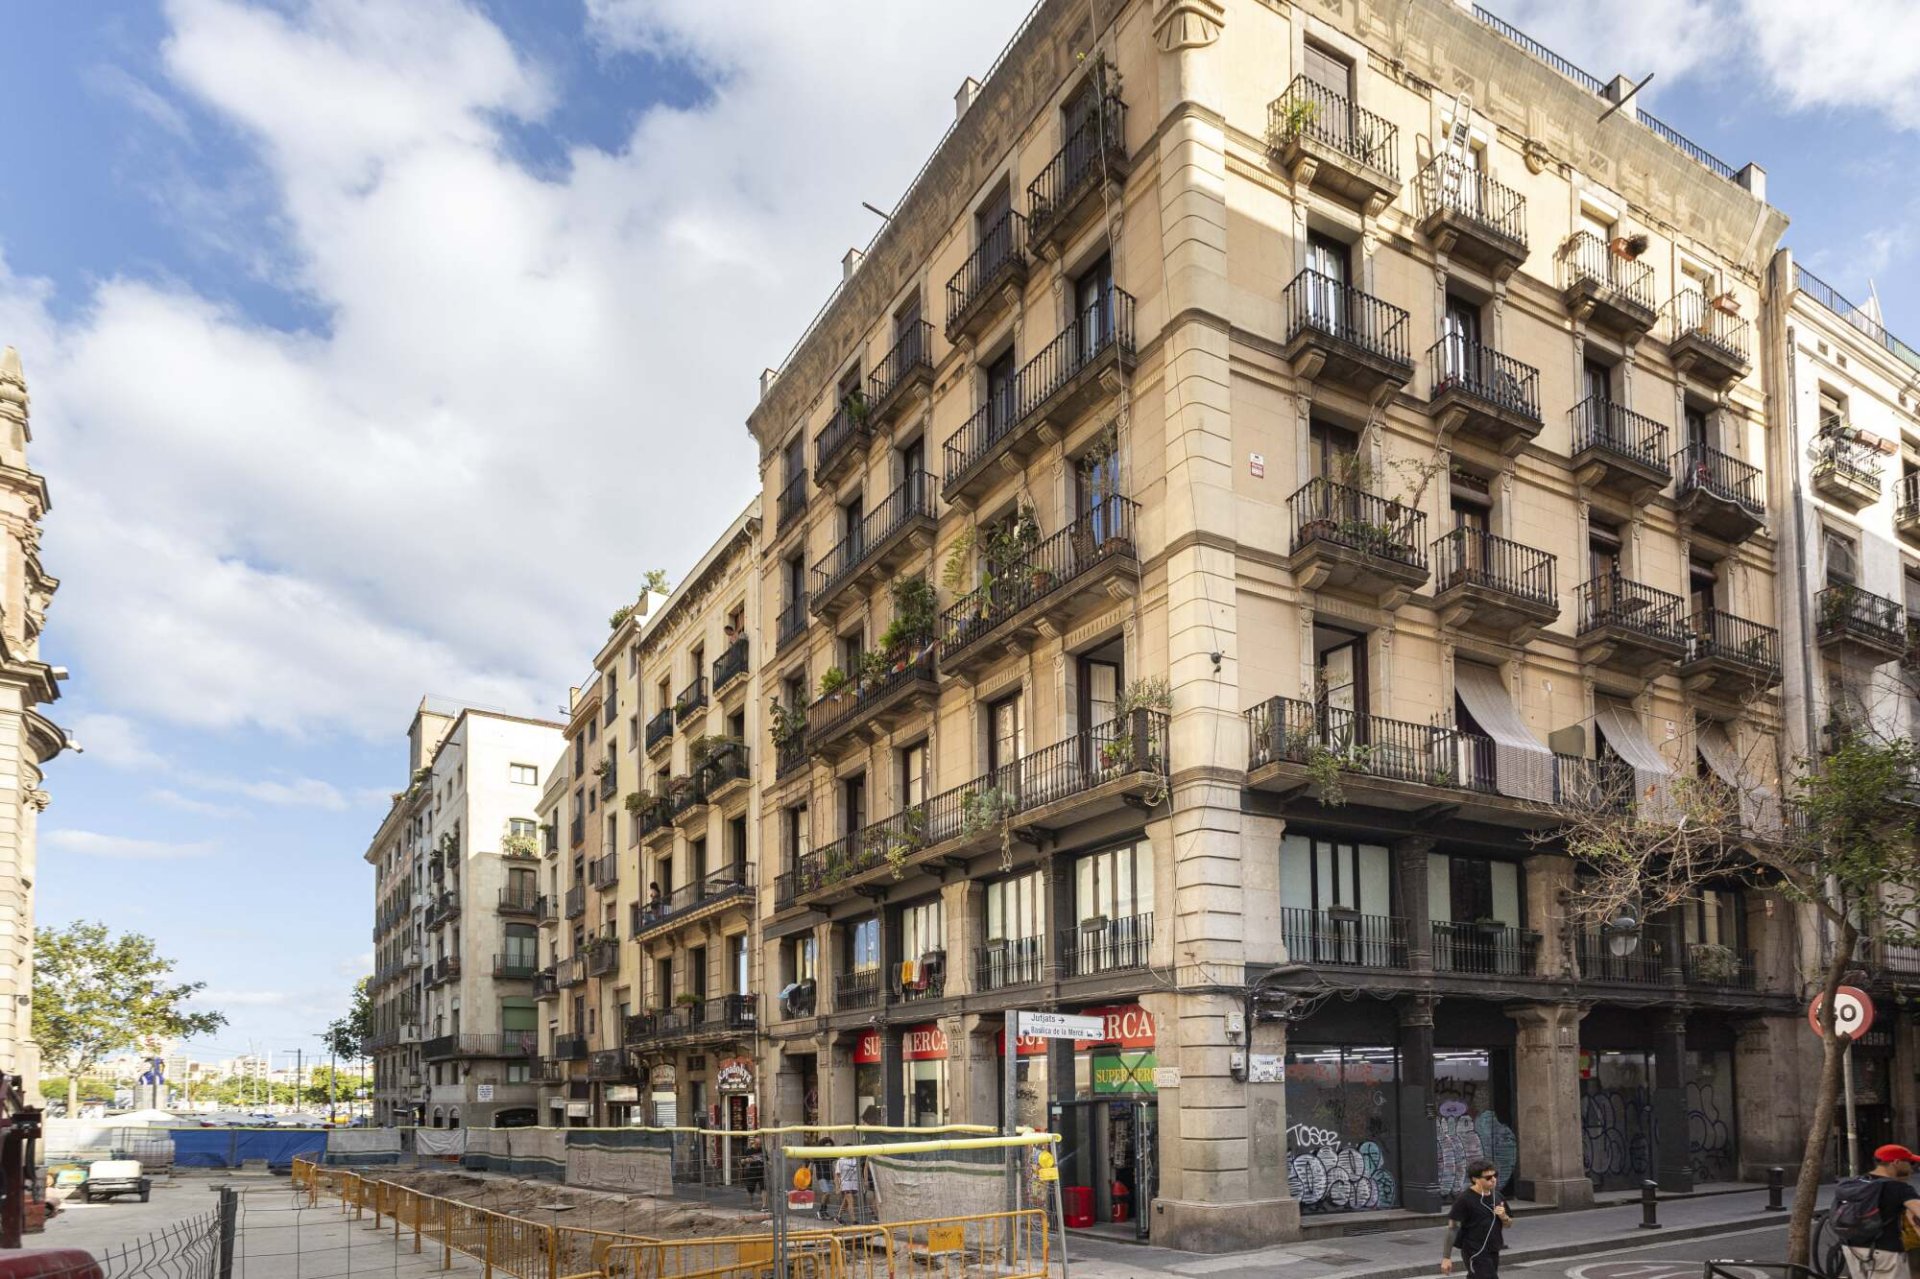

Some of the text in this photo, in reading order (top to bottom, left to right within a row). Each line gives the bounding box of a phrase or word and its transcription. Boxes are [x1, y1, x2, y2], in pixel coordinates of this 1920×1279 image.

[1031, 1013, 1056, 1023] Jutjats
[1053, 1028, 1060, 1036] de
[1061, 1028, 1067, 1036] la
